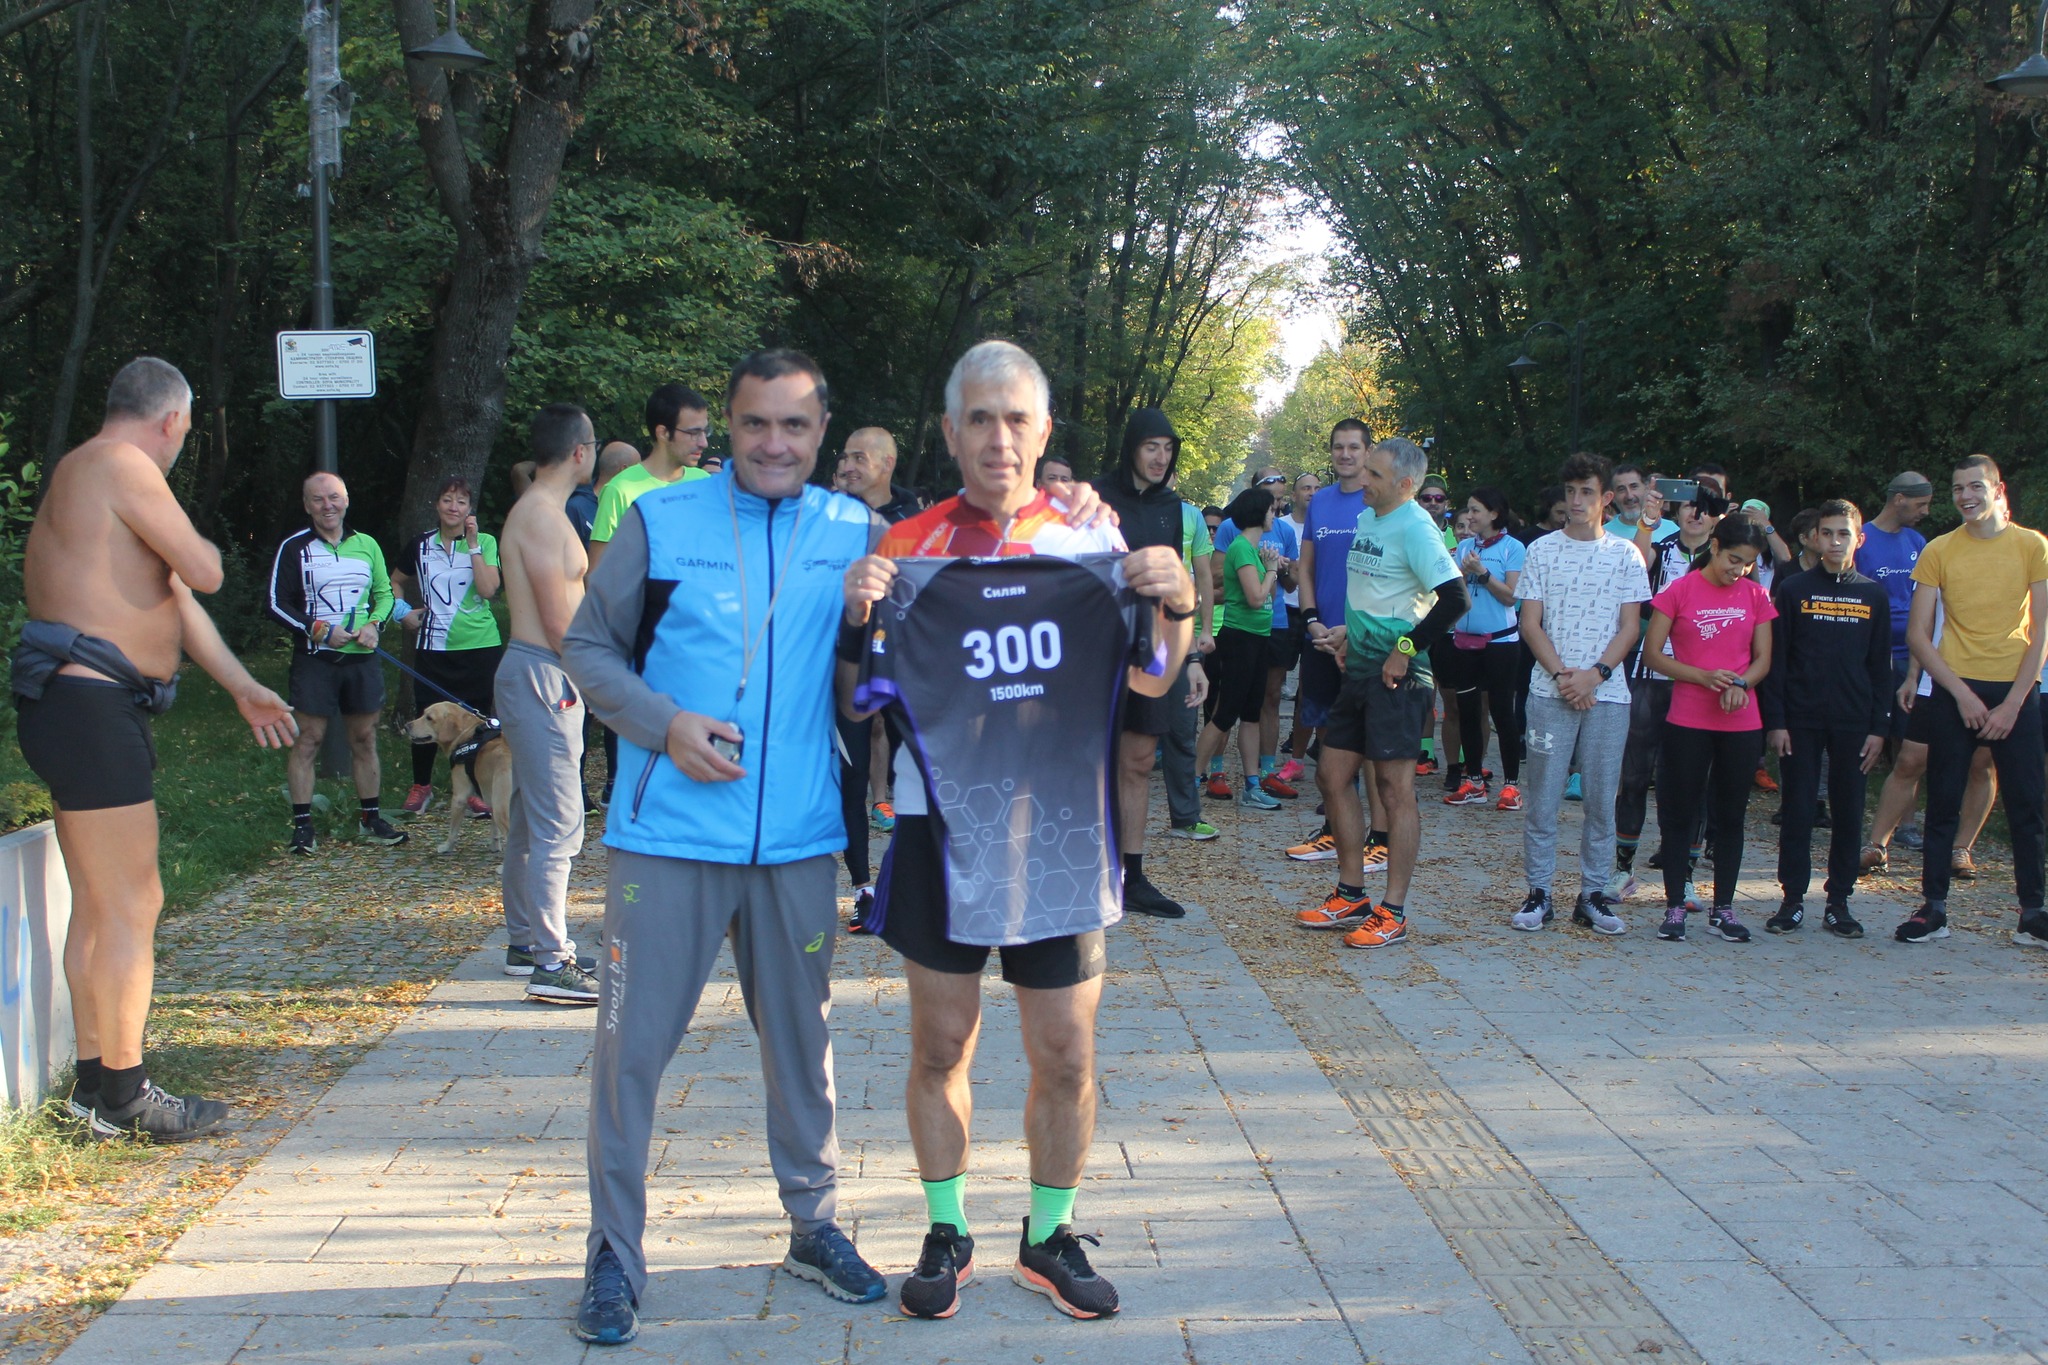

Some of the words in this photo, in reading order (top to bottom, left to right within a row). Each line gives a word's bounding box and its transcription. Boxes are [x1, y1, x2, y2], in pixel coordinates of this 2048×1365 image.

[675, 557, 735, 572] GARMIN
[982, 585, 1026, 599] Силян
[1801, 600, 1870, 616] Champion
[1700, 623, 1718, 634] 2013
[962, 620, 1062, 680] 300
[990, 683, 1044, 702] 1500km
[74, 1101, 92, 1113] Reebo
